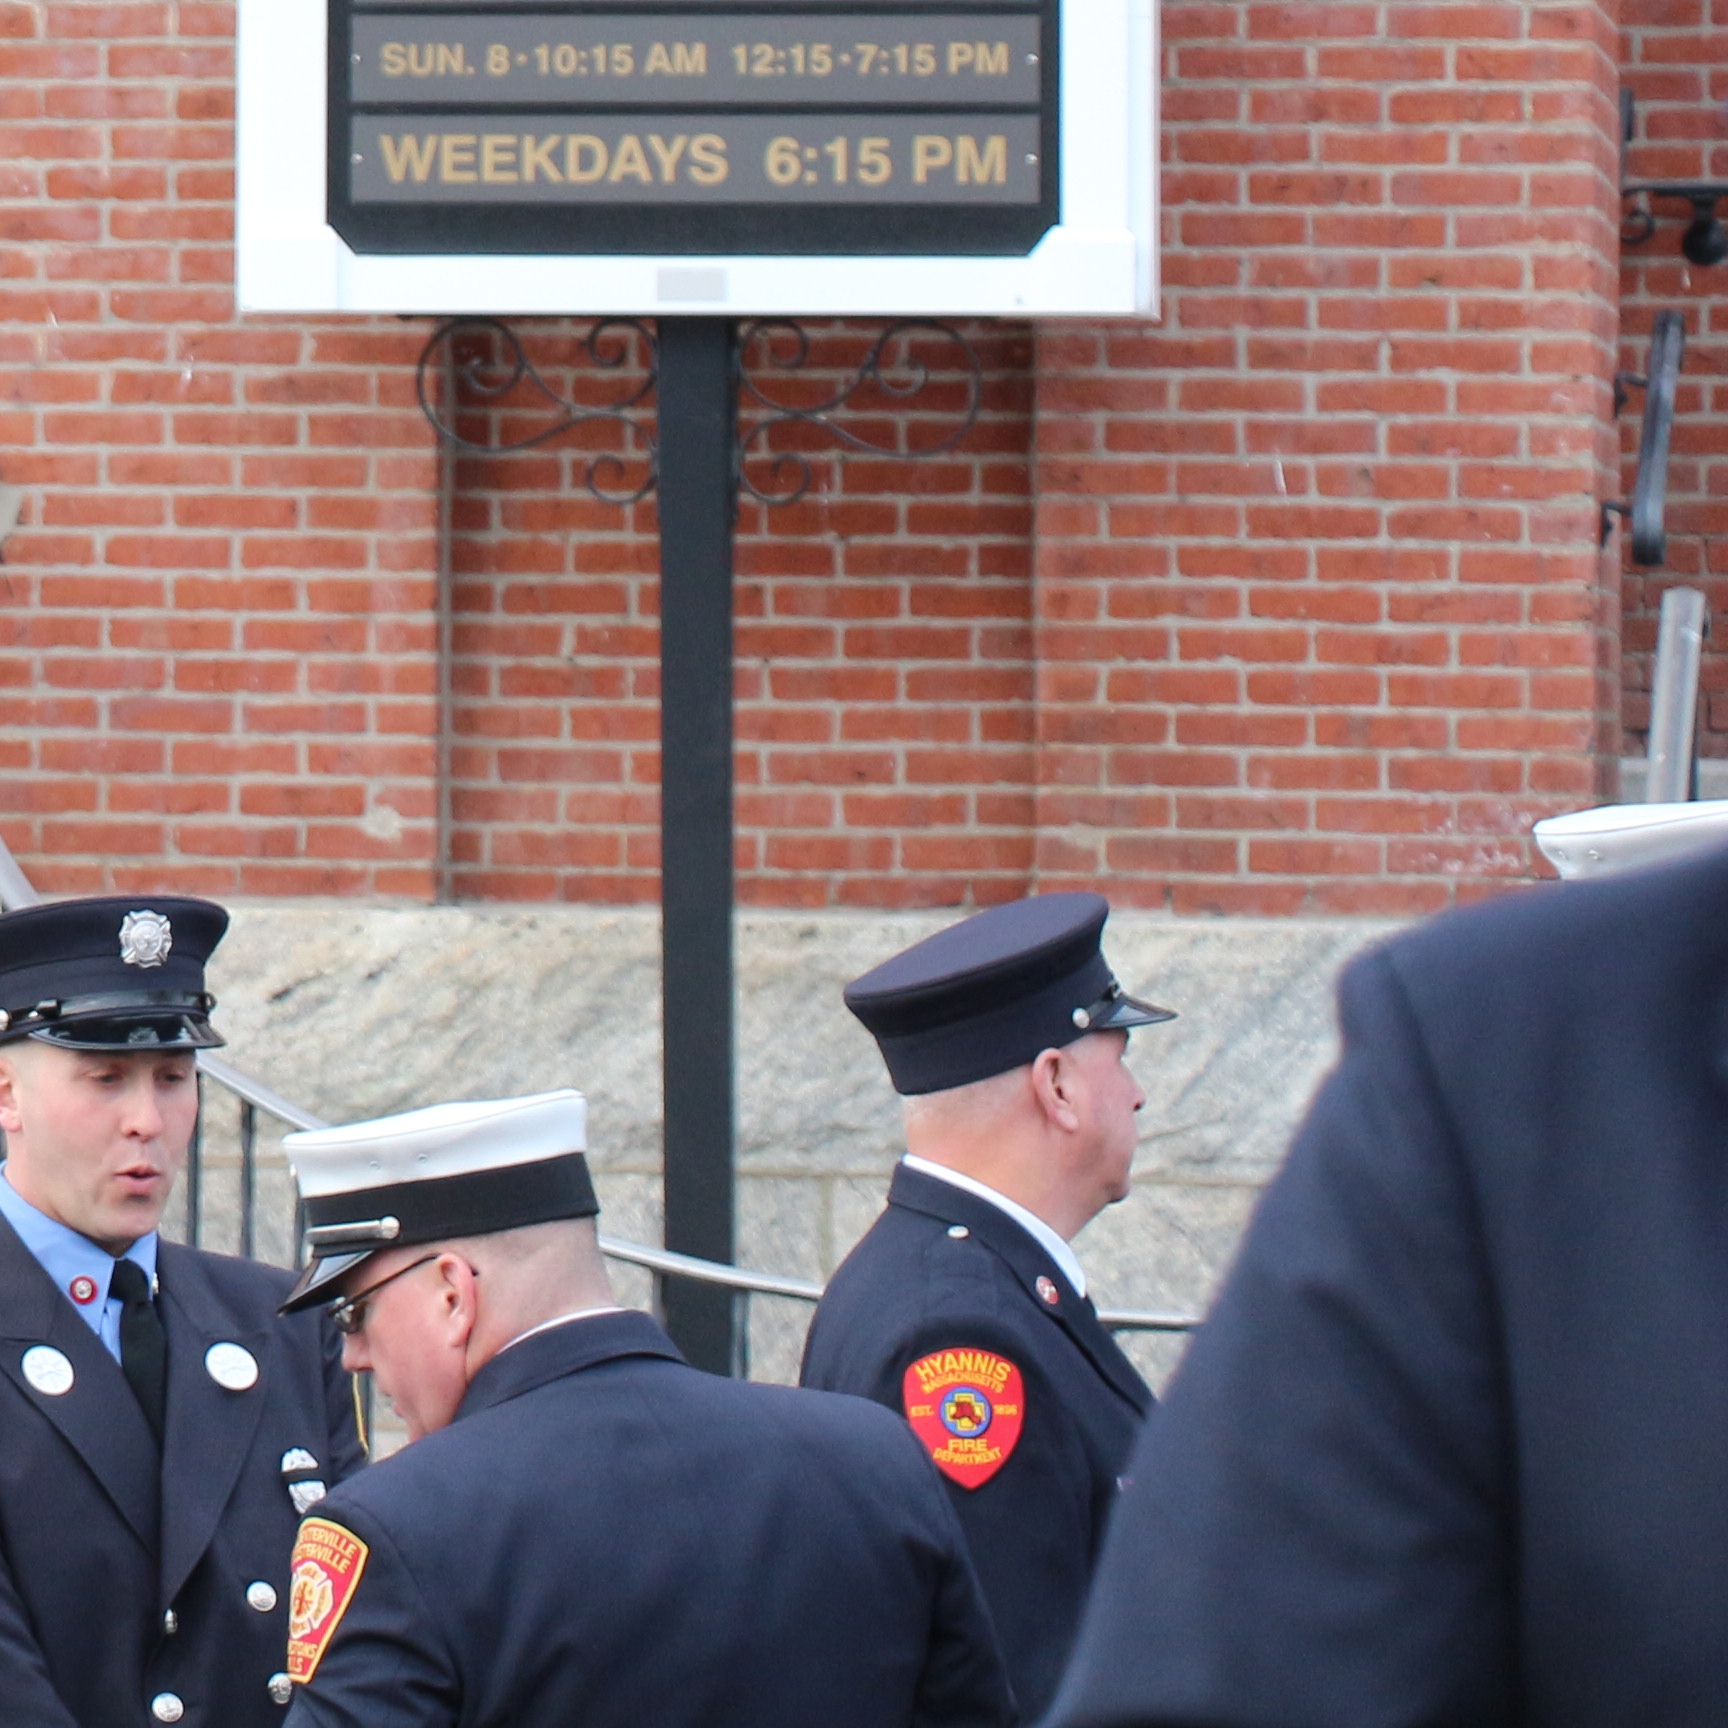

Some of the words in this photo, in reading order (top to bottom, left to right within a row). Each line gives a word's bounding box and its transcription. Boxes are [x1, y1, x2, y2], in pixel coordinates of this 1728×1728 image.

[380, 41, 476, 78] SUN.
[643, 41, 708, 76] AM
[947, 41, 1011, 76] PM
[378, 133, 731, 187] WEEKDAYS
[764, 135, 893, 187] 6:15
[912, 134, 1009, 186] PM
[915, 1351, 1012, 1381] HYANNIS
[948, 1438, 988, 1451] FIRE
